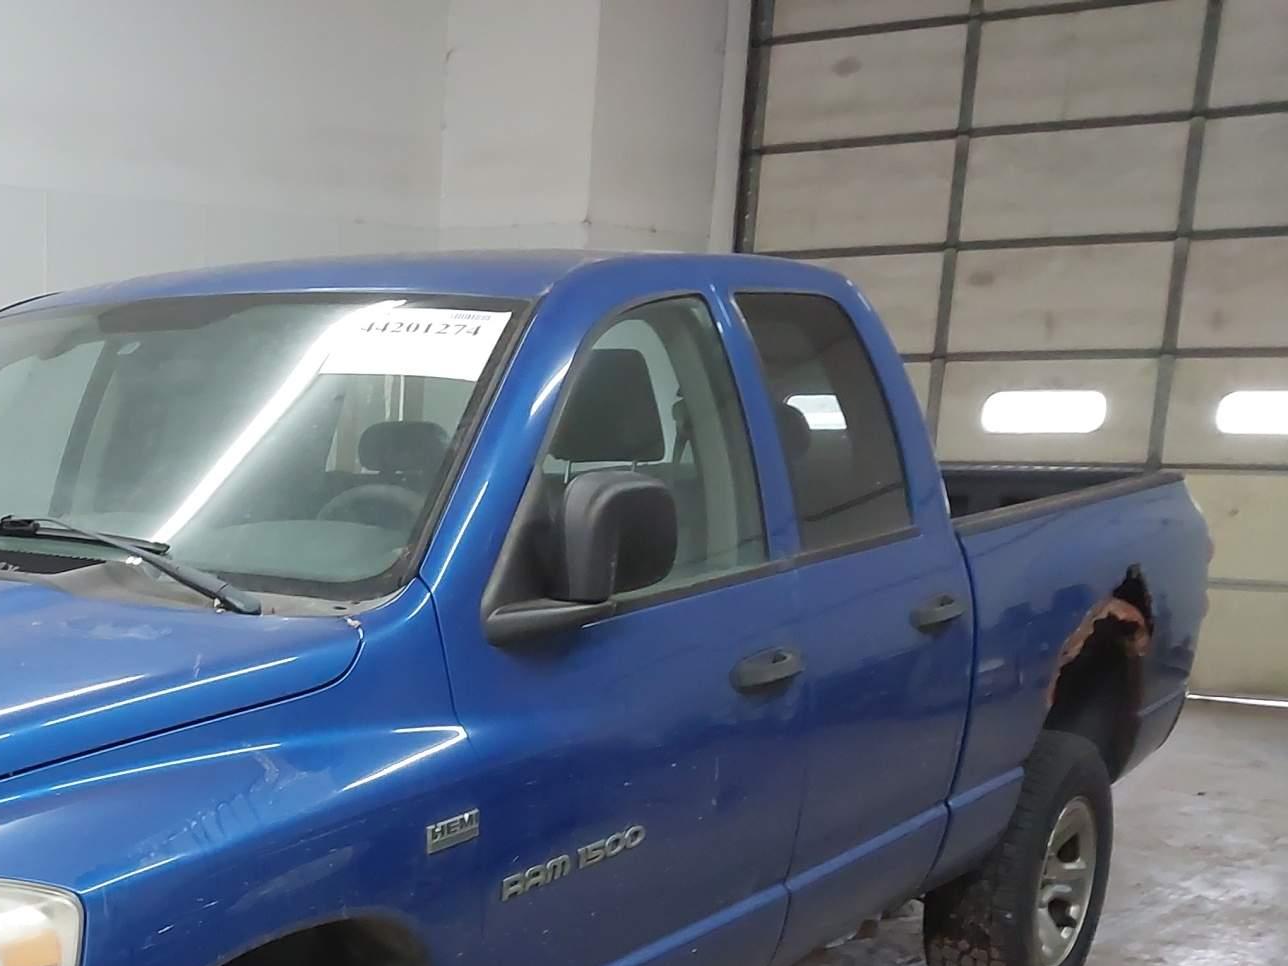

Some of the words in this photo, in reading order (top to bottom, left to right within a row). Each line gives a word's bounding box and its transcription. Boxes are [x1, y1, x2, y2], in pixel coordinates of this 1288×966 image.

[360, 321, 482, 337] 44201274
[501, 854, 571, 902] RAM
[577, 824, 647, 869] 1500
